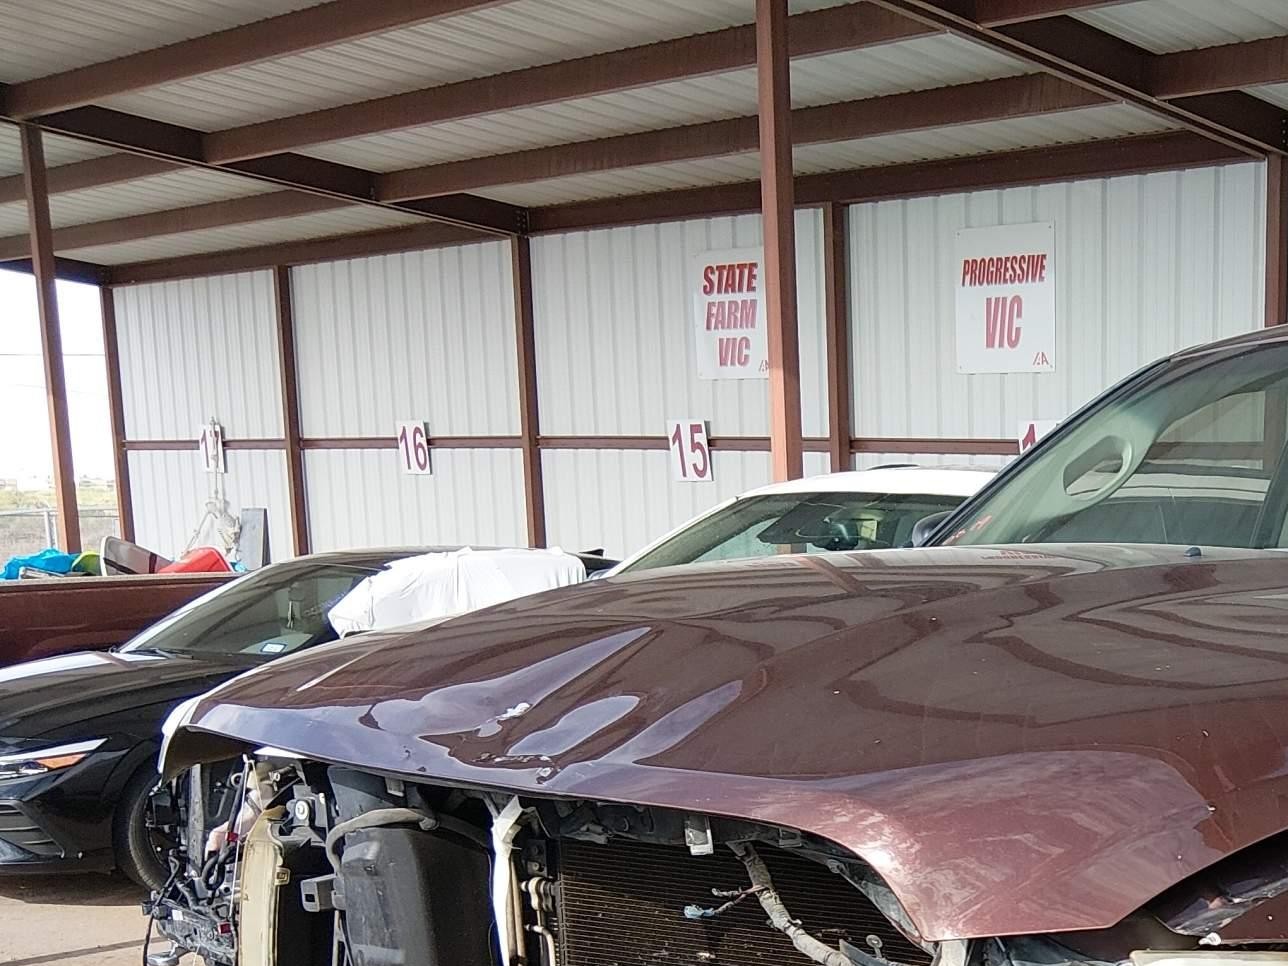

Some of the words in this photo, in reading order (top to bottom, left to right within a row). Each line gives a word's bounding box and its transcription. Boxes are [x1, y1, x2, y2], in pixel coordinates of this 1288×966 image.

[703, 262, 758, 296] STATE
[962, 253, 1047, 287] PROGRESSIVE
[706, 299, 758, 331] FARM
[985, 294, 1023, 349] VIC
[718, 336, 751, 367] VIC
[399, 425, 427, 471] 16
[672, 423, 707, 478] 15
